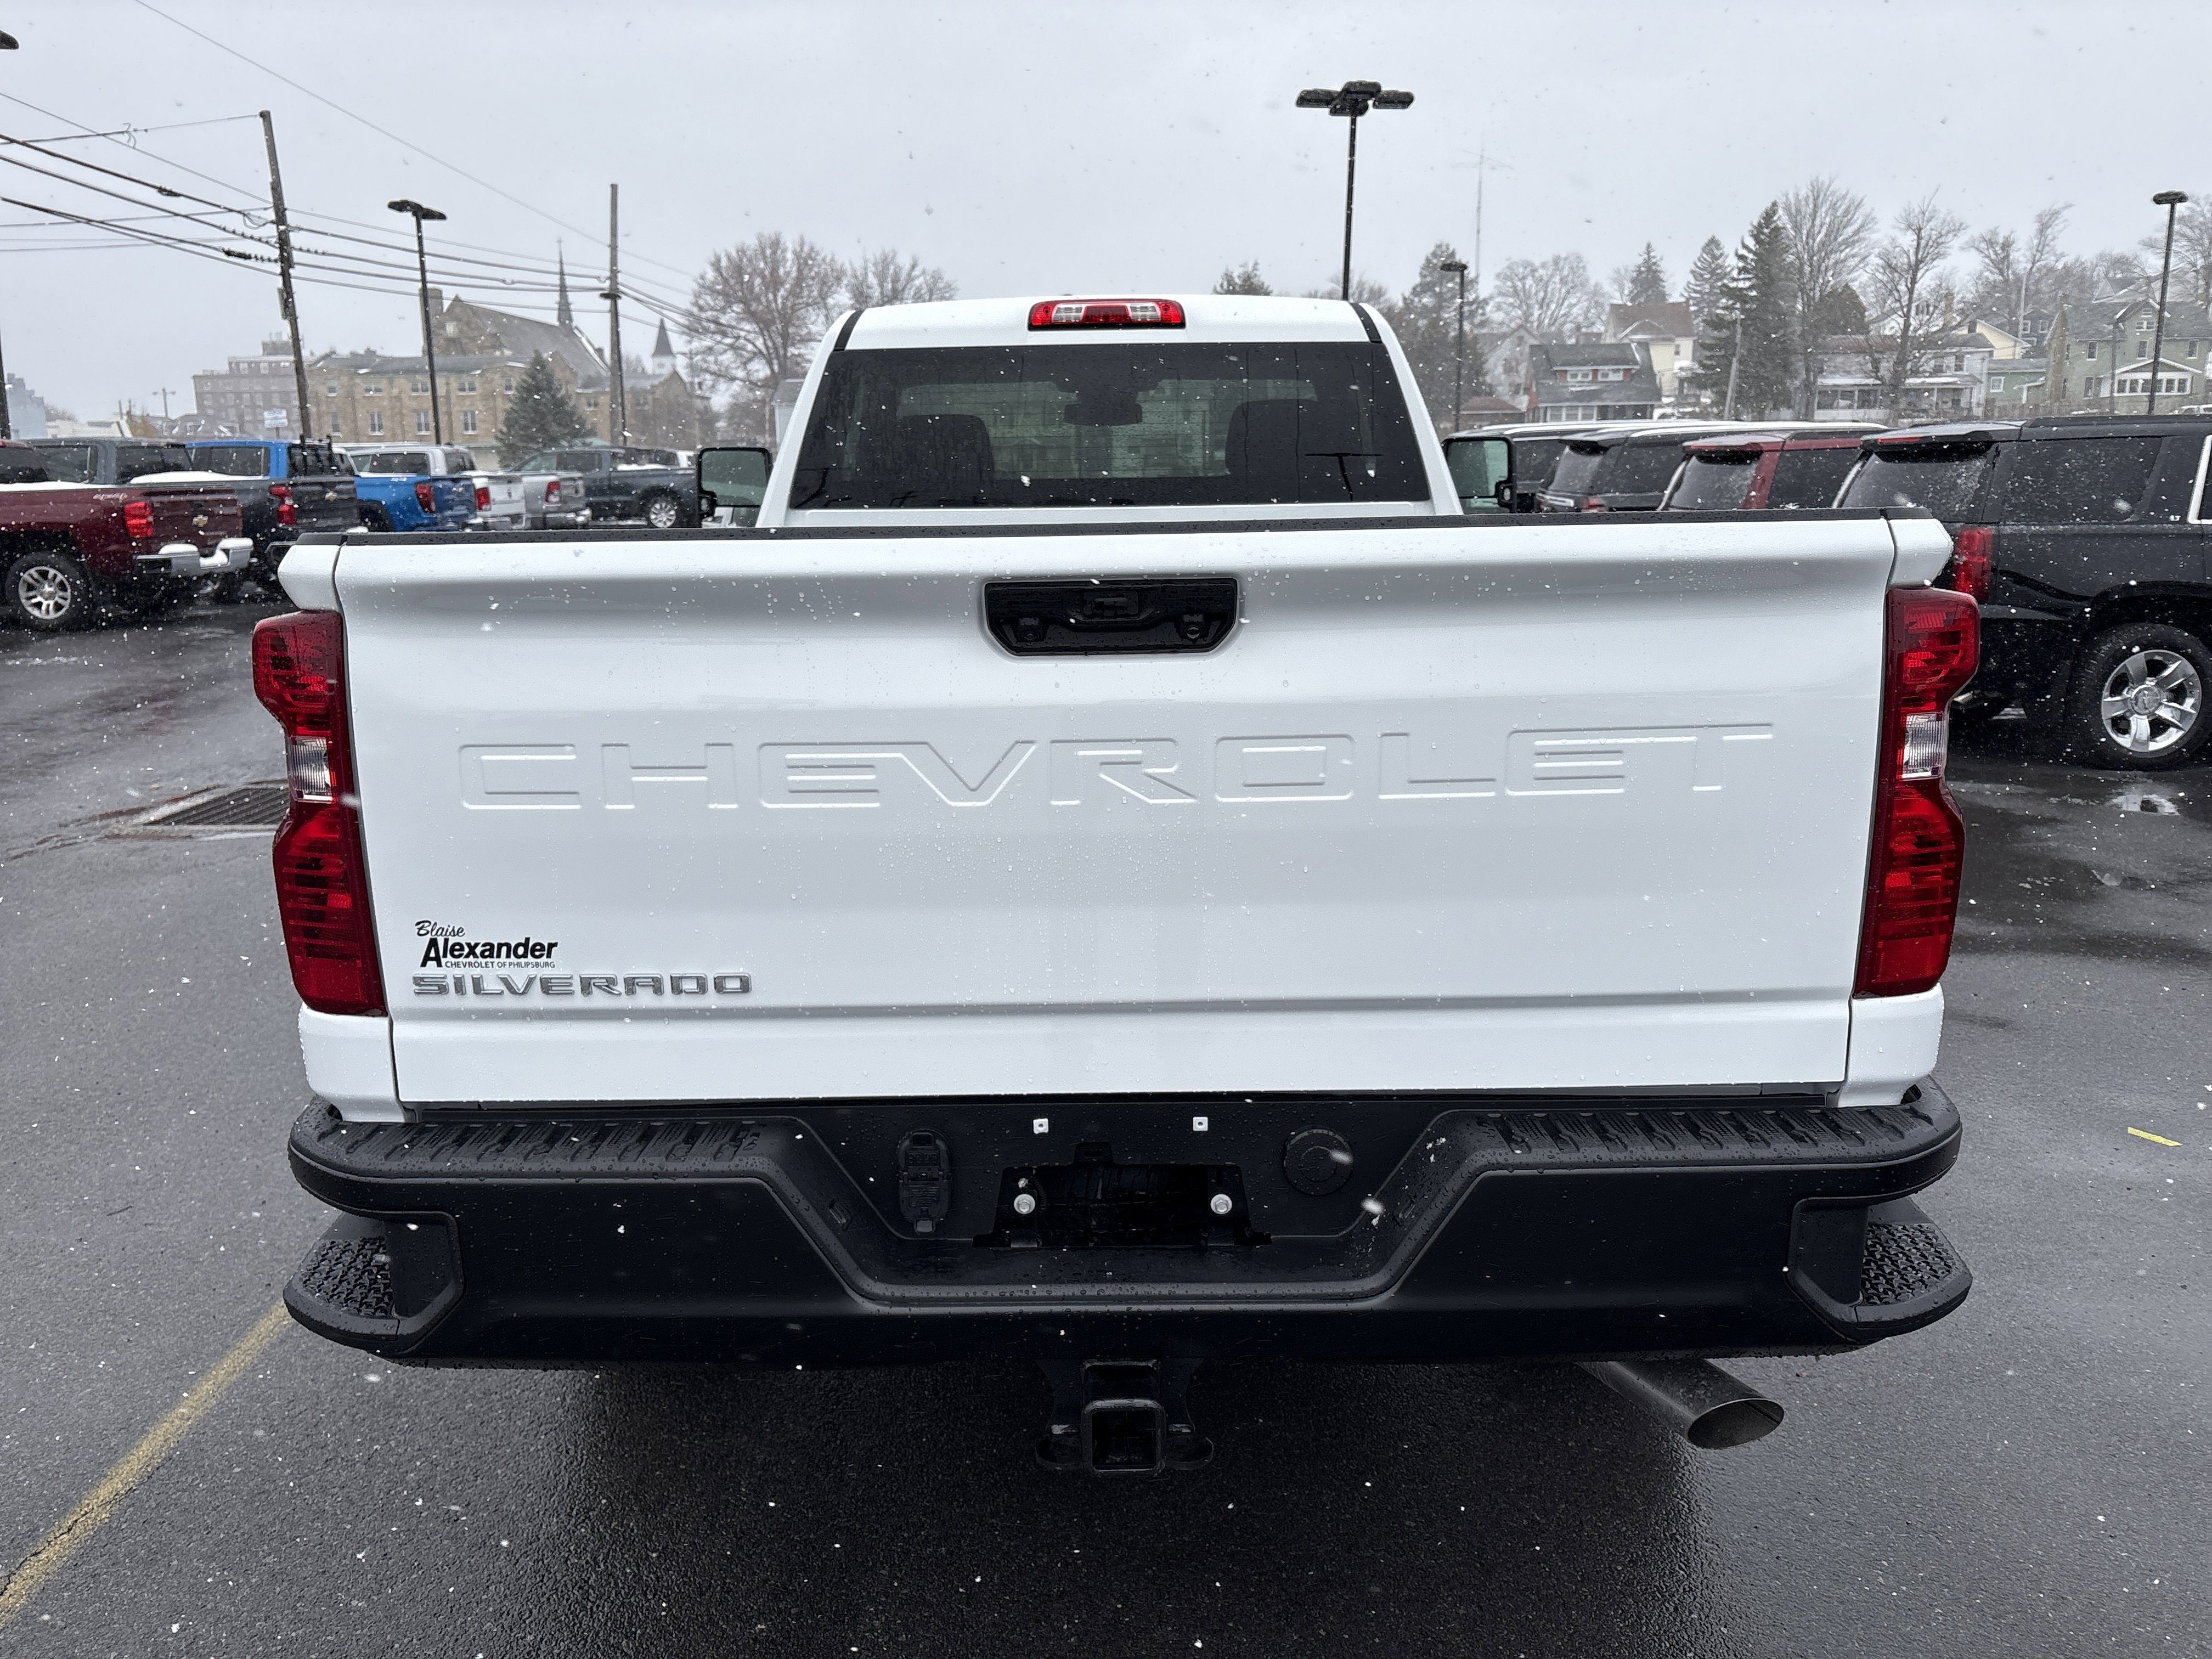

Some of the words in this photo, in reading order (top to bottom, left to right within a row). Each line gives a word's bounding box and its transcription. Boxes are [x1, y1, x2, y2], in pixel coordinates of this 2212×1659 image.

[459, 723, 1774, 809] CHEVROLET
[414, 920, 466, 937] Blaise
[420, 936, 558, 968] Alexander
[412, 973, 752, 996] SILVERADO
